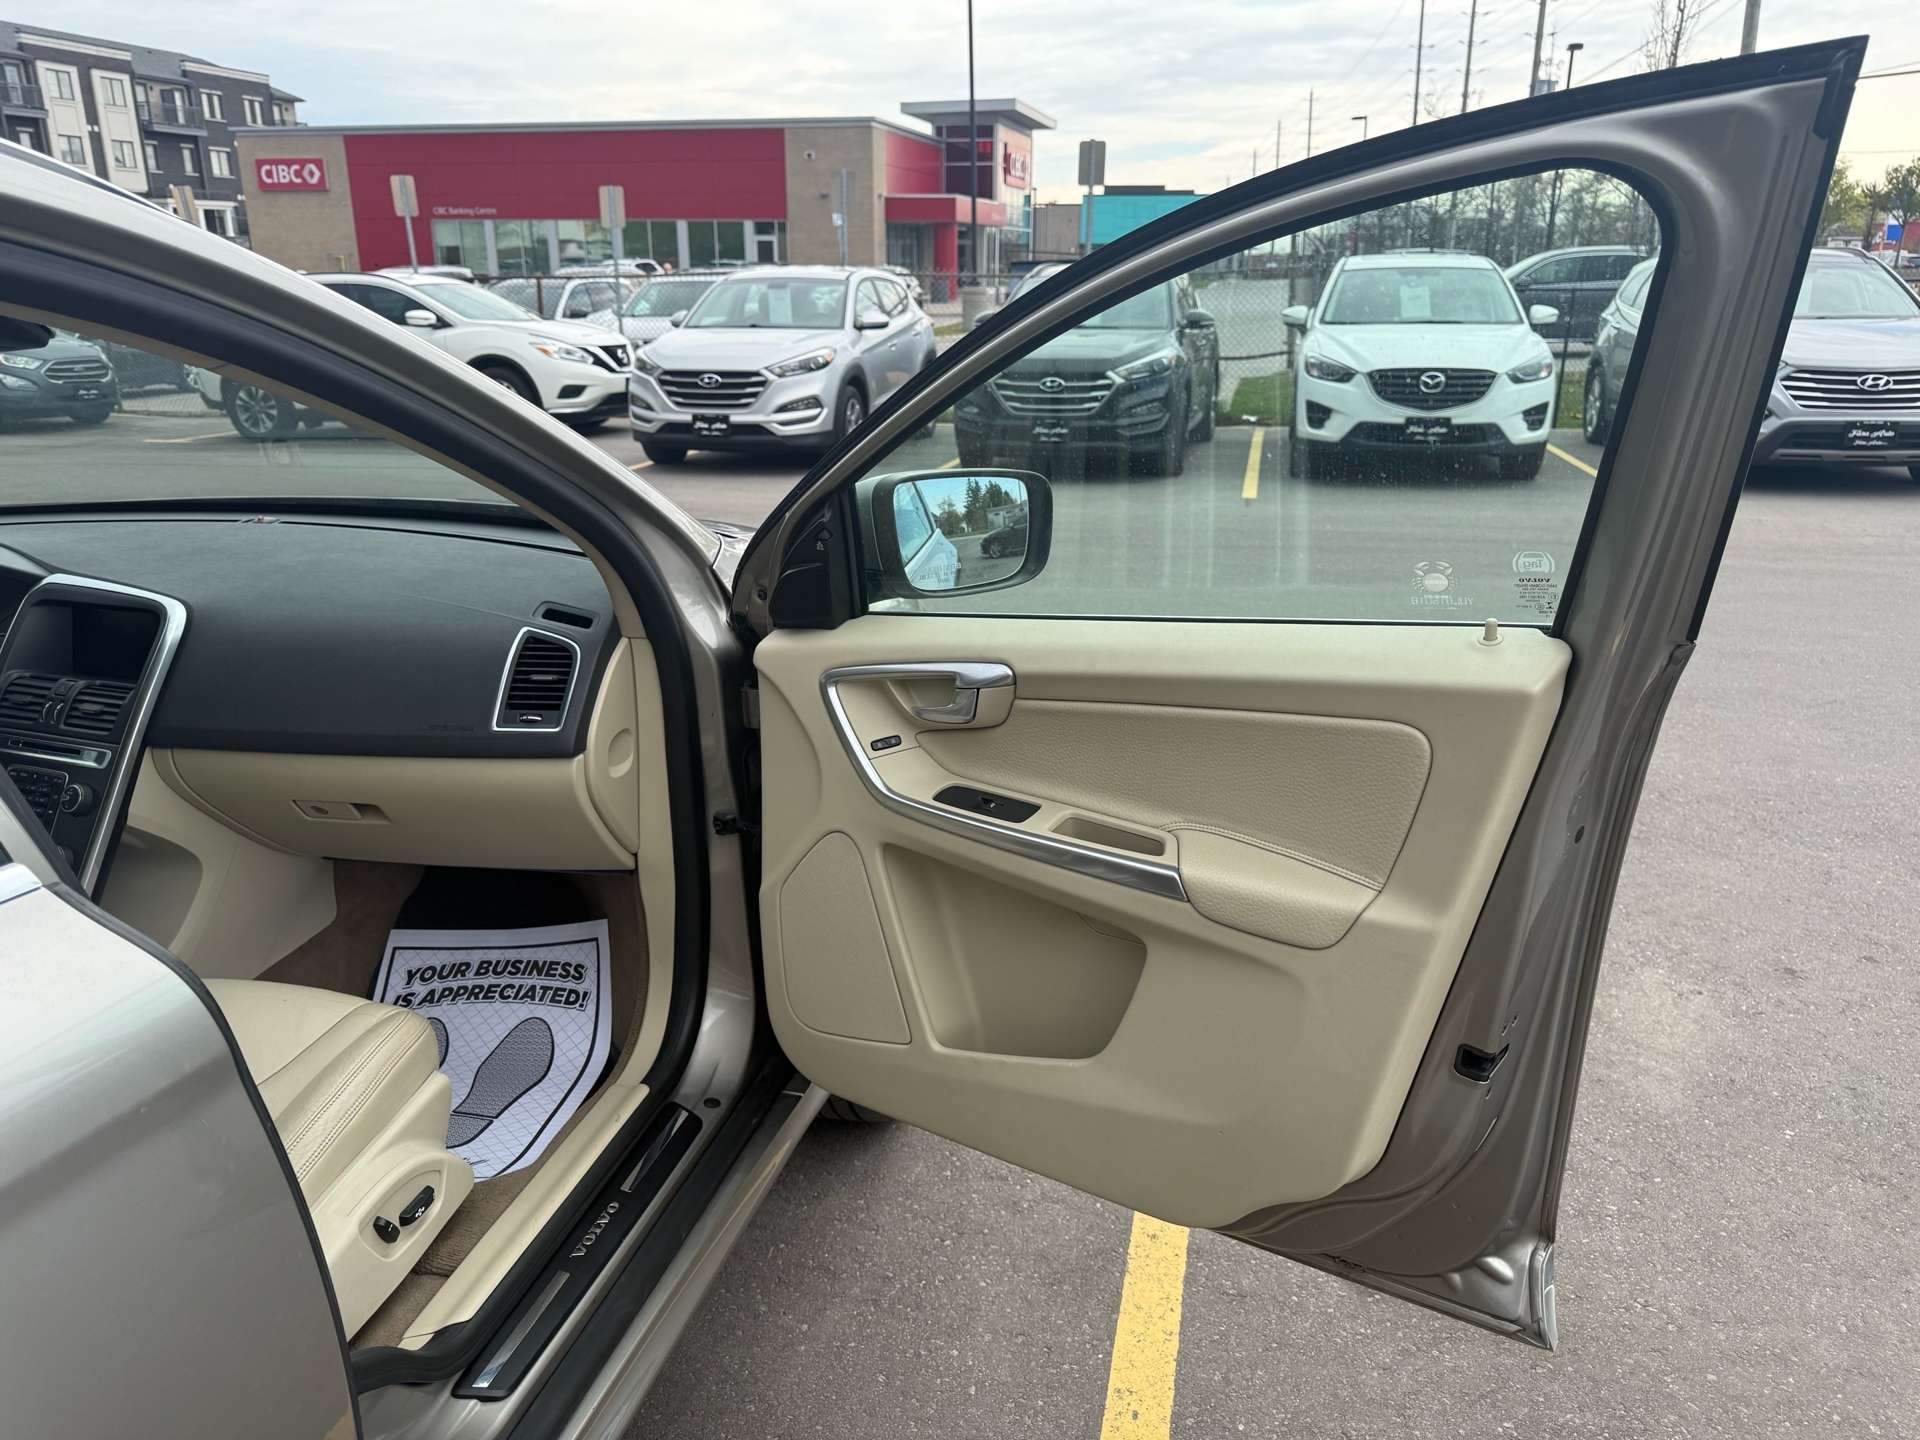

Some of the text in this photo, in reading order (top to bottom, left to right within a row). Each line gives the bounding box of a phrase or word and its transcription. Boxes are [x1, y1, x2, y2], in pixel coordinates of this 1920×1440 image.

[260, 164, 302, 185] CIBC
[404, 959, 587, 985] YOUR BUSINESS
[393, 984, 591, 1010] IS APPRECIATED!
[568, 1202, 620, 1258] VOLVO
